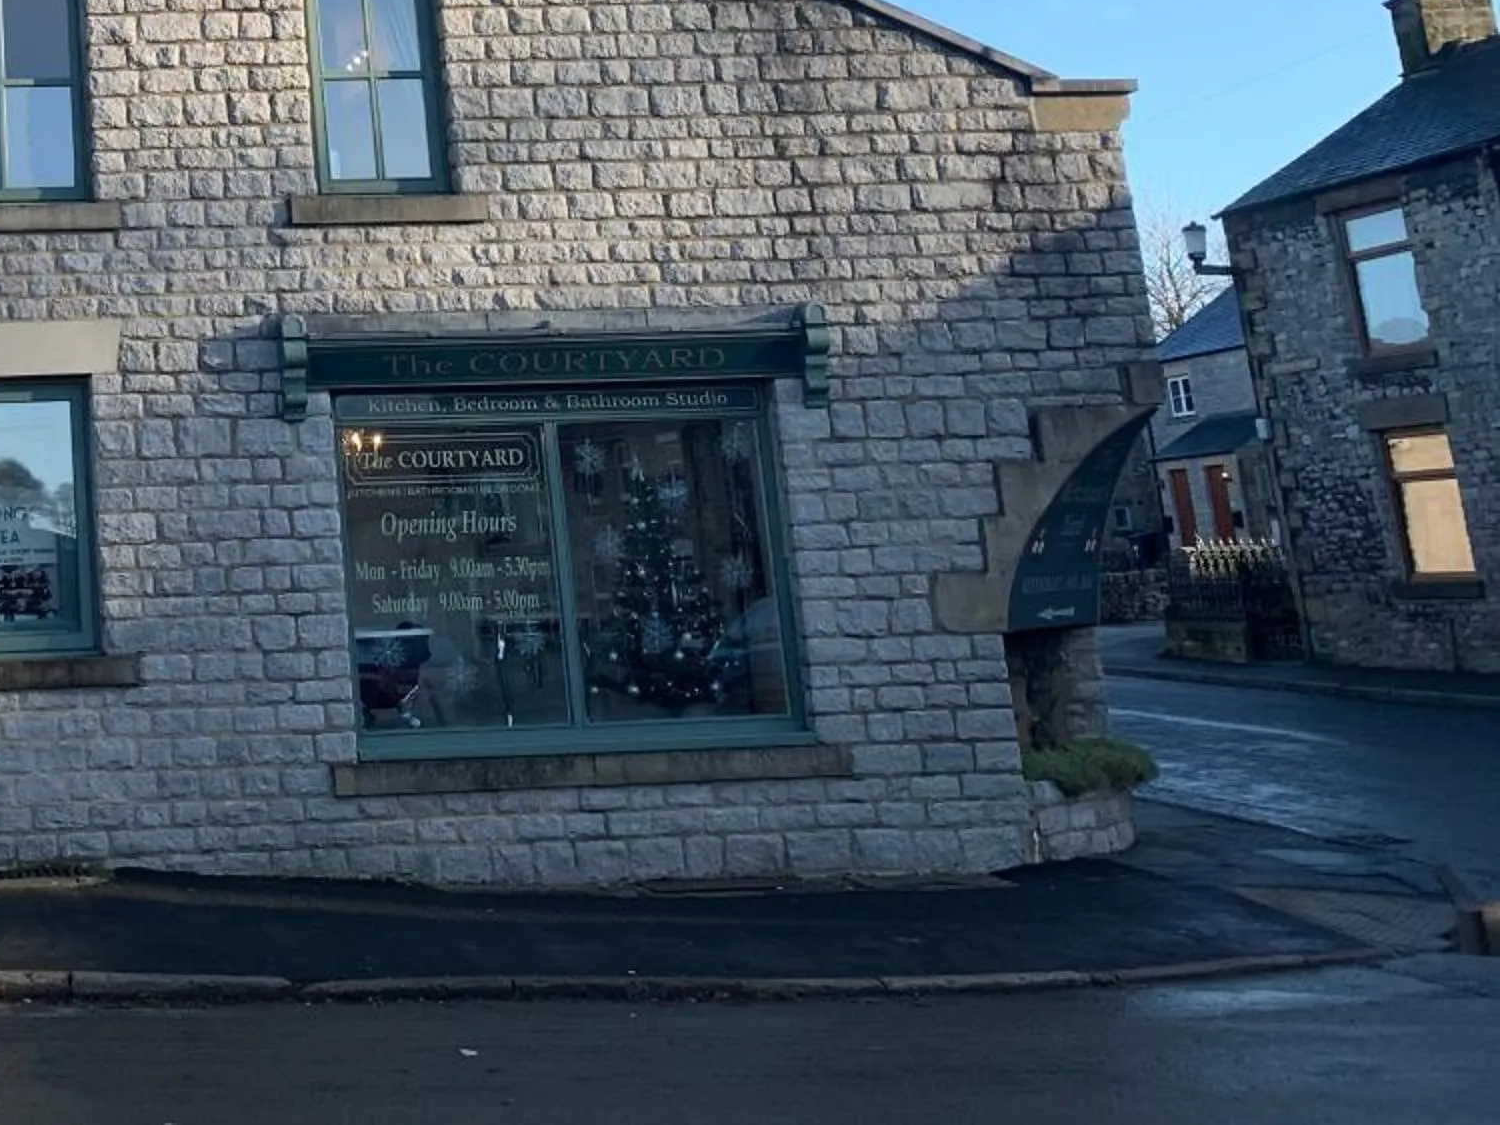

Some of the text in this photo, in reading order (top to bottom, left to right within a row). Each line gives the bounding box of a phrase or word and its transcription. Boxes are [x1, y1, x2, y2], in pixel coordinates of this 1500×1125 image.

[382, 348, 726, 376] The COURTYARD
[454, 395, 538, 412] Bedroom
[544, 395, 561, 410] &
[566, 393, 660, 410] Bathroom
[666, 390, 727, 407] Studio
[398, 448, 524, 468] COURTYARD
[381, 510, 518, 543] Opening Hours
[355, 560, 386, 581] Mon
[401, 559, 441, 585] Friday
[371, 591, 431, 619] Saturday
